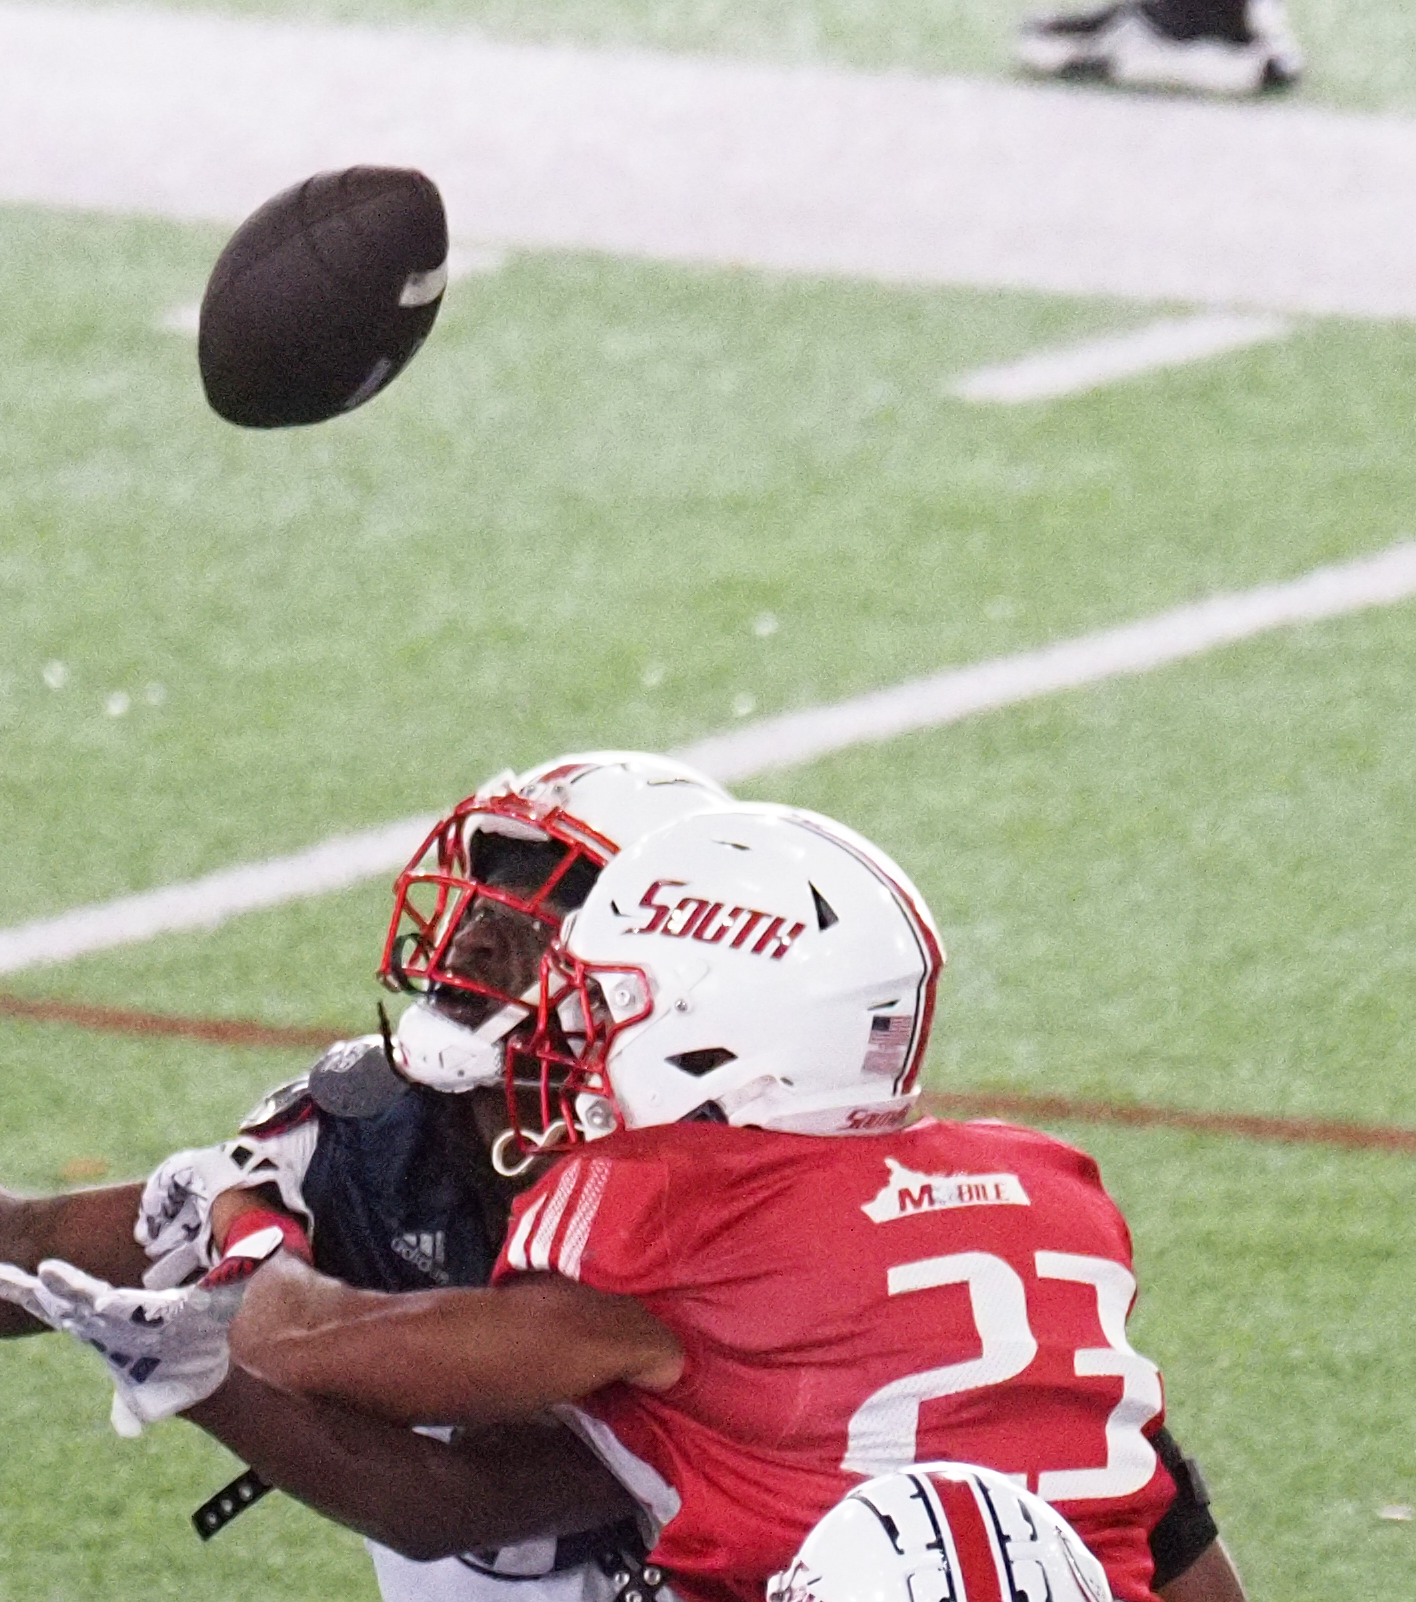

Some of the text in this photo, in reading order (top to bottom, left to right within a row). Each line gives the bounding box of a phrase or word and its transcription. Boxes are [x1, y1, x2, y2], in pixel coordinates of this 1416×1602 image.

[621, 879, 807, 961] SOUTH
[897, 1183, 1011, 1212] MBILE
[839, 1250, 1165, 1501] 23
